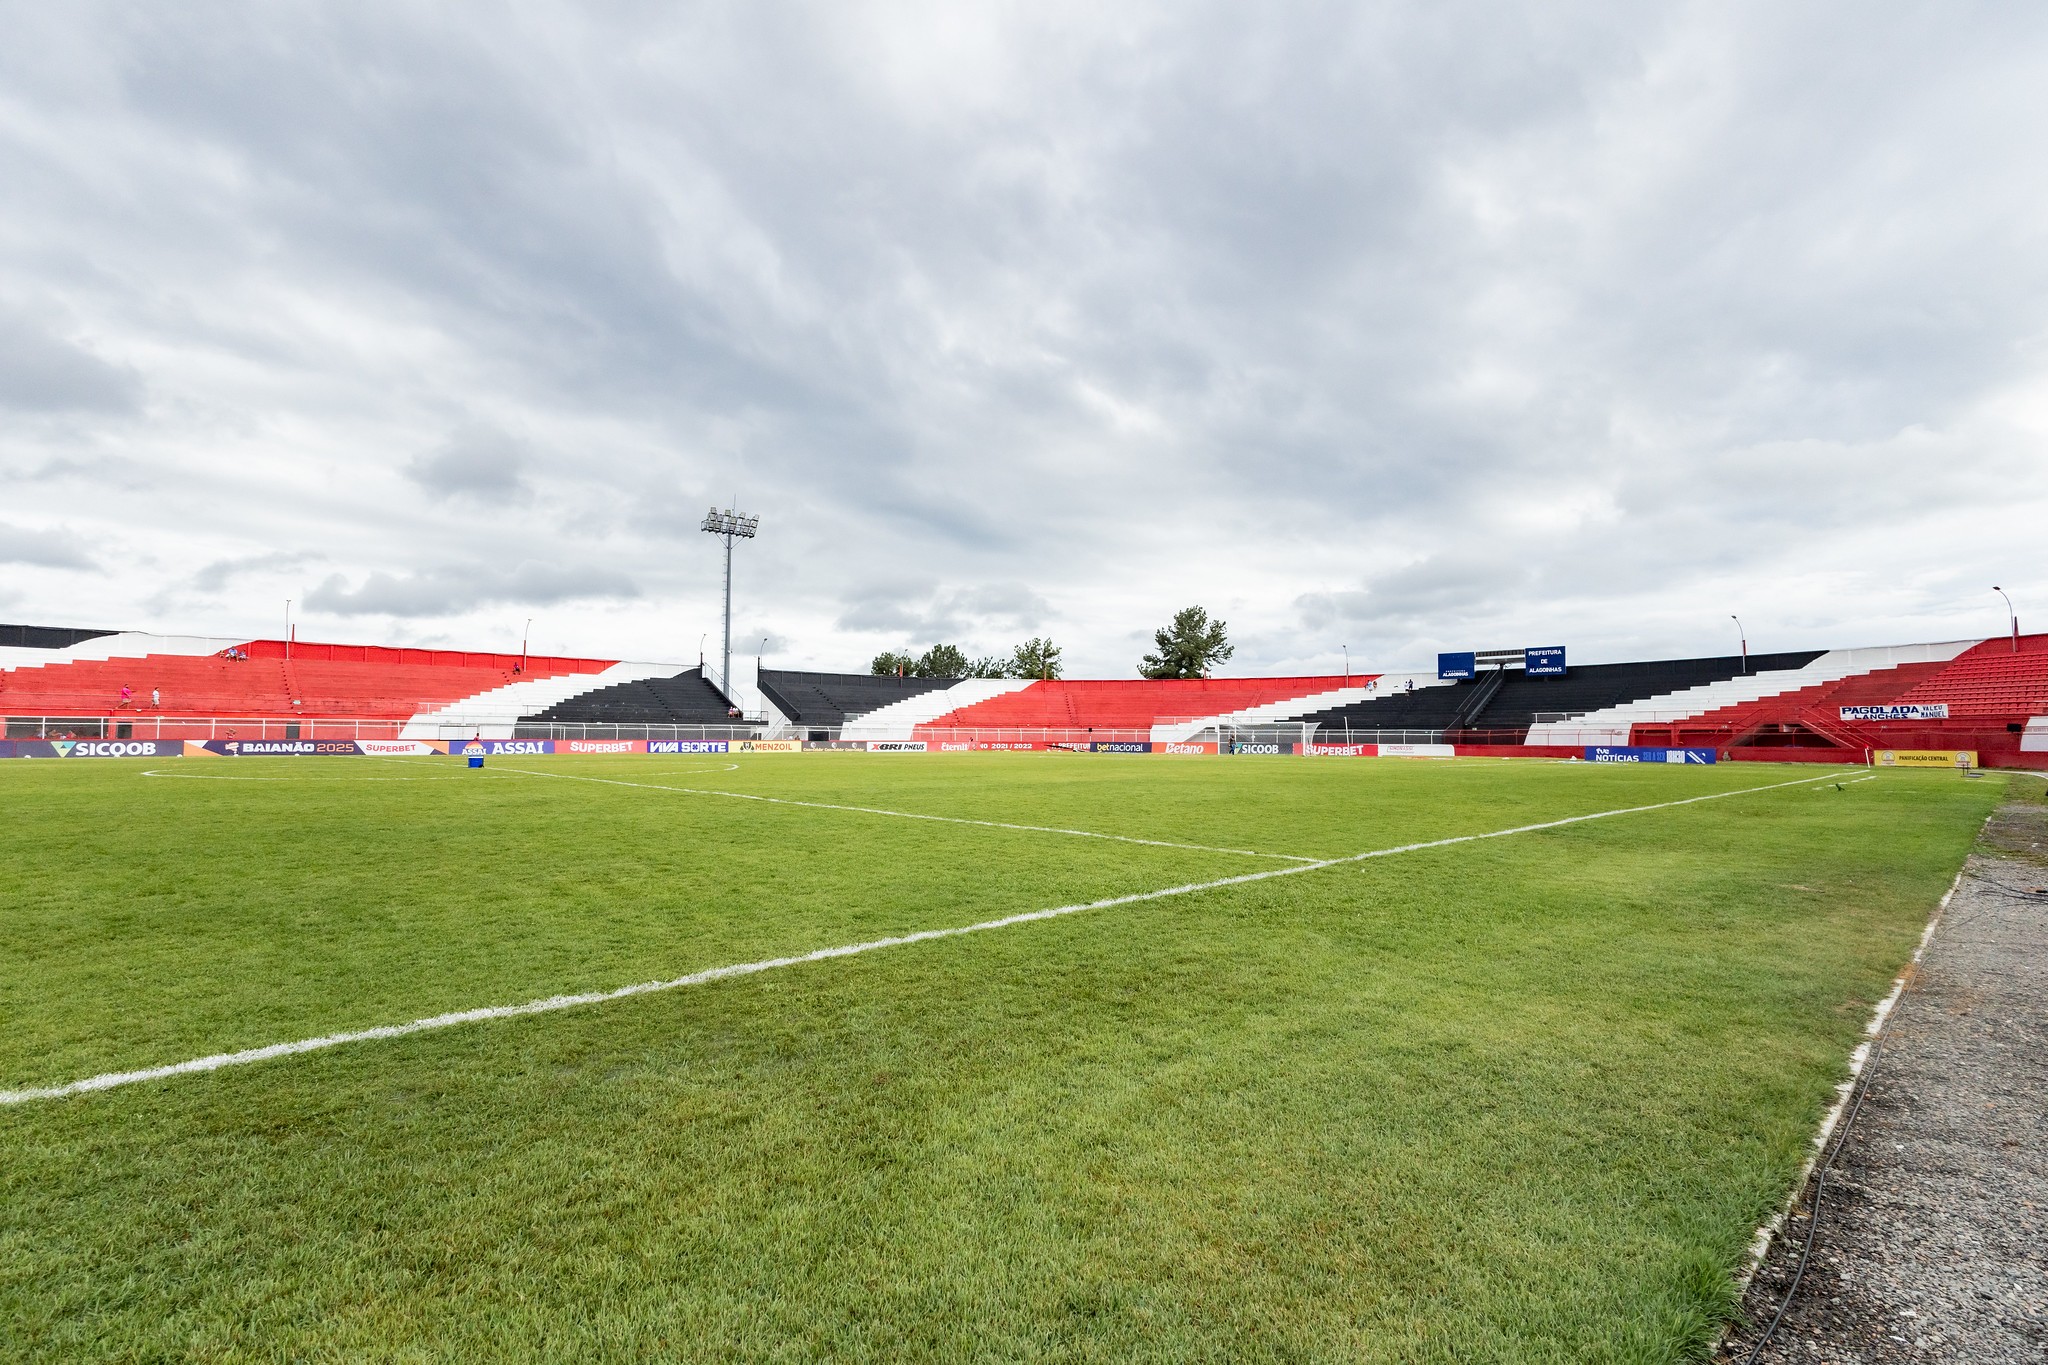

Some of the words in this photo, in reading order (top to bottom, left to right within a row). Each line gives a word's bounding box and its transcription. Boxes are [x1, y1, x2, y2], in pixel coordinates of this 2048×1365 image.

[1841, 706, 1919, 715] PAGOLADA
[75, 742, 156, 756] SICOOB
[242, 742, 315, 753] BAIANÃO
[316, 743, 354, 753] 2025
[366, 743, 416, 753] SUPERBET
[570, 741, 634, 754] SUPERBET
[649, 742, 679, 753] VIVA
[681, 742, 727, 753] SORTE
[755, 743, 793, 751] MENZOIL
[903, 743, 925, 751] PNEUS
[1165, 742, 1204, 754] Betano
[1241, 744, 1279, 754] SICOOB
[1306, 745, 1364, 756] SUPERBET
[1595, 753, 1640, 762] NOTÍCIAS
